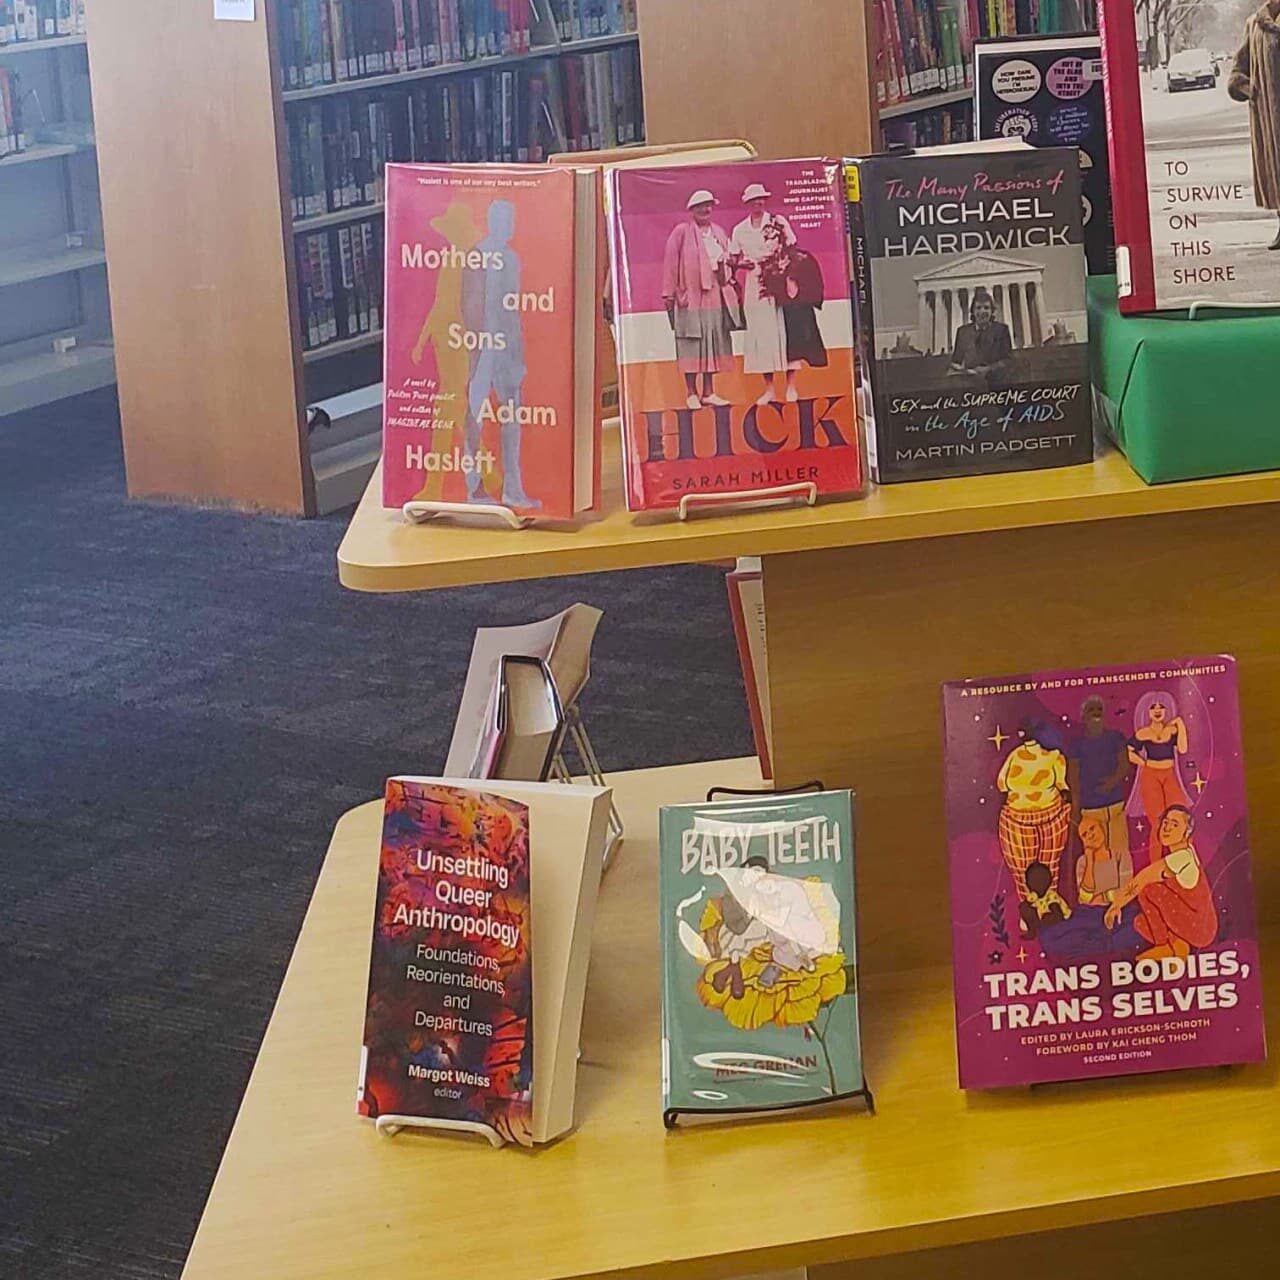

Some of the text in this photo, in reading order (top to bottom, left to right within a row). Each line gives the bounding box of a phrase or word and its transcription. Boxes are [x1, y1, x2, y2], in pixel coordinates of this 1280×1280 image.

[1164, 160, 1189, 176] TO
[885, 169, 1065, 200] The Many Passions of
[1166, 184, 1244, 204] SURVIVE
[899, 197, 1054, 227] MICHAEL
[1169, 214, 1198, 230] ON
[884, 225, 1071, 258] HARDWICK
[1170, 241, 1212, 258] THIS
[400, 243, 505, 271] Mothers
[1173, 265, 1236, 285] SHORE
[502, 287, 555, 313] and
[448, 322, 506, 351] Sons
[476, 397, 557, 426] Adam
[890, 384, 1081, 414] SEX and the SUPREME COURT
[640, 396, 849, 463] HICK
[904, 402, 1066, 440] in the Age of AIDS
[406, 444, 496, 474] Haslett
[896, 434, 1076, 461] MARTIN PADGETT
[672, 466, 820, 491] SARAH MILLER
[961, 664, 1226, 698] A RESOURCE BY AND FOR TRANSGENDER COMMUNITIES
[680, 818, 842, 875] BABY TEETH
[416, 848, 509, 890] Unsettling
[434, 880, 492, 909] Queer
[393, 904, 520, 948] Anthropology
[416, 944, 501, 973] Foundations,
[406, 966, 506, 998] Reorientations,
[984, 951, 1250, 998] TRANS BODIES,
[443, 994, 470, 1010] and
[985, 982, 1239, 1032] TRANS SELVES
[414, 1010, 493, 1037] Departures
[1021, 1018, 1211, 1046] EDITED BY LAURA ERICKSON-SCHROTH
[1036, 1031, 1198, 1056] FOREWORD BY KAI CHENG THOM
[408, 1064, 490, 1088] Margot Weiss
[434, 1088, 462, 1100] editor
